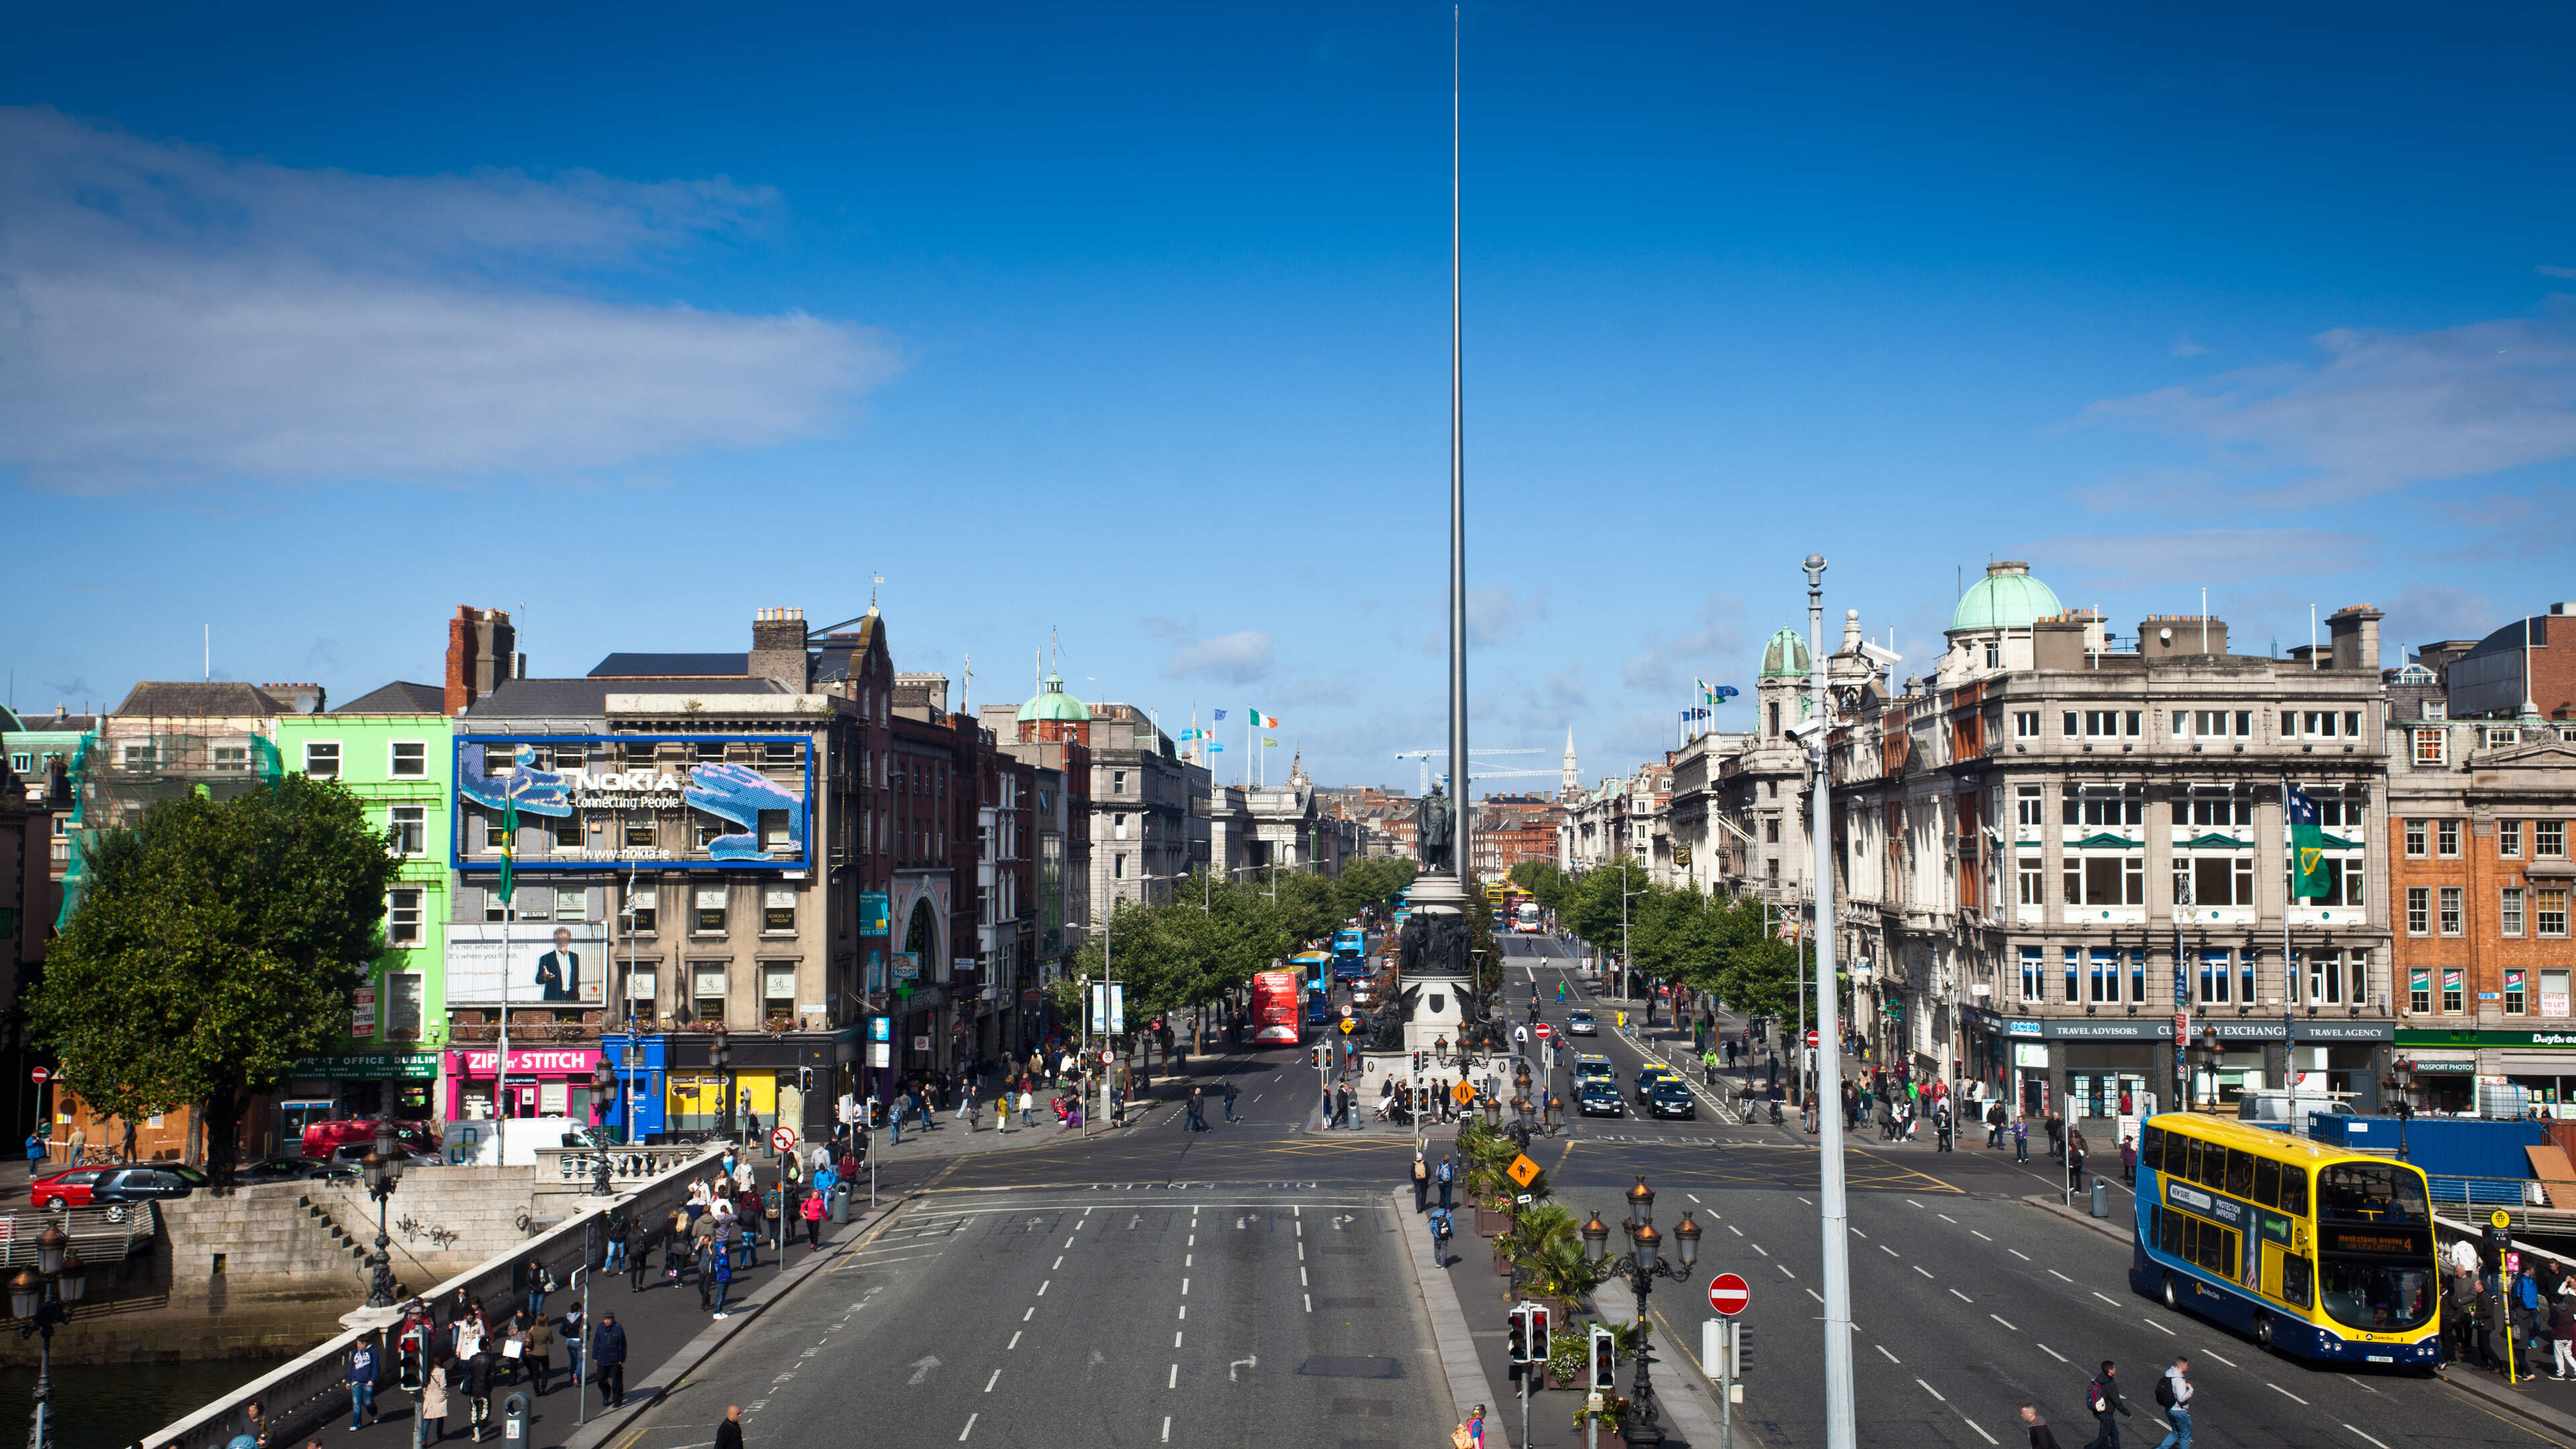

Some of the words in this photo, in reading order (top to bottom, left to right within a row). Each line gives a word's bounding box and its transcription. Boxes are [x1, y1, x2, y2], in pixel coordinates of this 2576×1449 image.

[576, 773, 679, 792] NOKIA
[575, 796, 637, 810] Connecting
[641, 796, 679, 810] People
[583, 848, 670, 860] www.nokia.ie
[2445, 976, 2459, 984] PORT
[2508, 974, 2519, 983] ID
[354, 1014, 374, 1022] OFFICES
[2056, 1026, 2090, 1035] TRAVEL
[2091, 1026, 2138, 1035] ADVISORS
[2157, 1026, 2221, 1035] CUENY
[2309, 1028, 2343, 1036] TRAVEL
[2345, 1028, 2383, 1037] AGENCY
[343, 1057, 385, 1065] OFFICE
[394, 1056, 437, 1065] DUBLIN
[469, 1053, 498, 1069] ZIP
[521, 1053, 585, 1069] STITCH
[2180, 1189, 2190, 1199] SURE
[2216, 1198, 2241, 1214] PROTECTION
[2216, 1207, 2237, 1222] IMPROVED
[2339, 1234, 2377, 1244] Monkstown
[2404, 1238, 2412, 1252] 4
